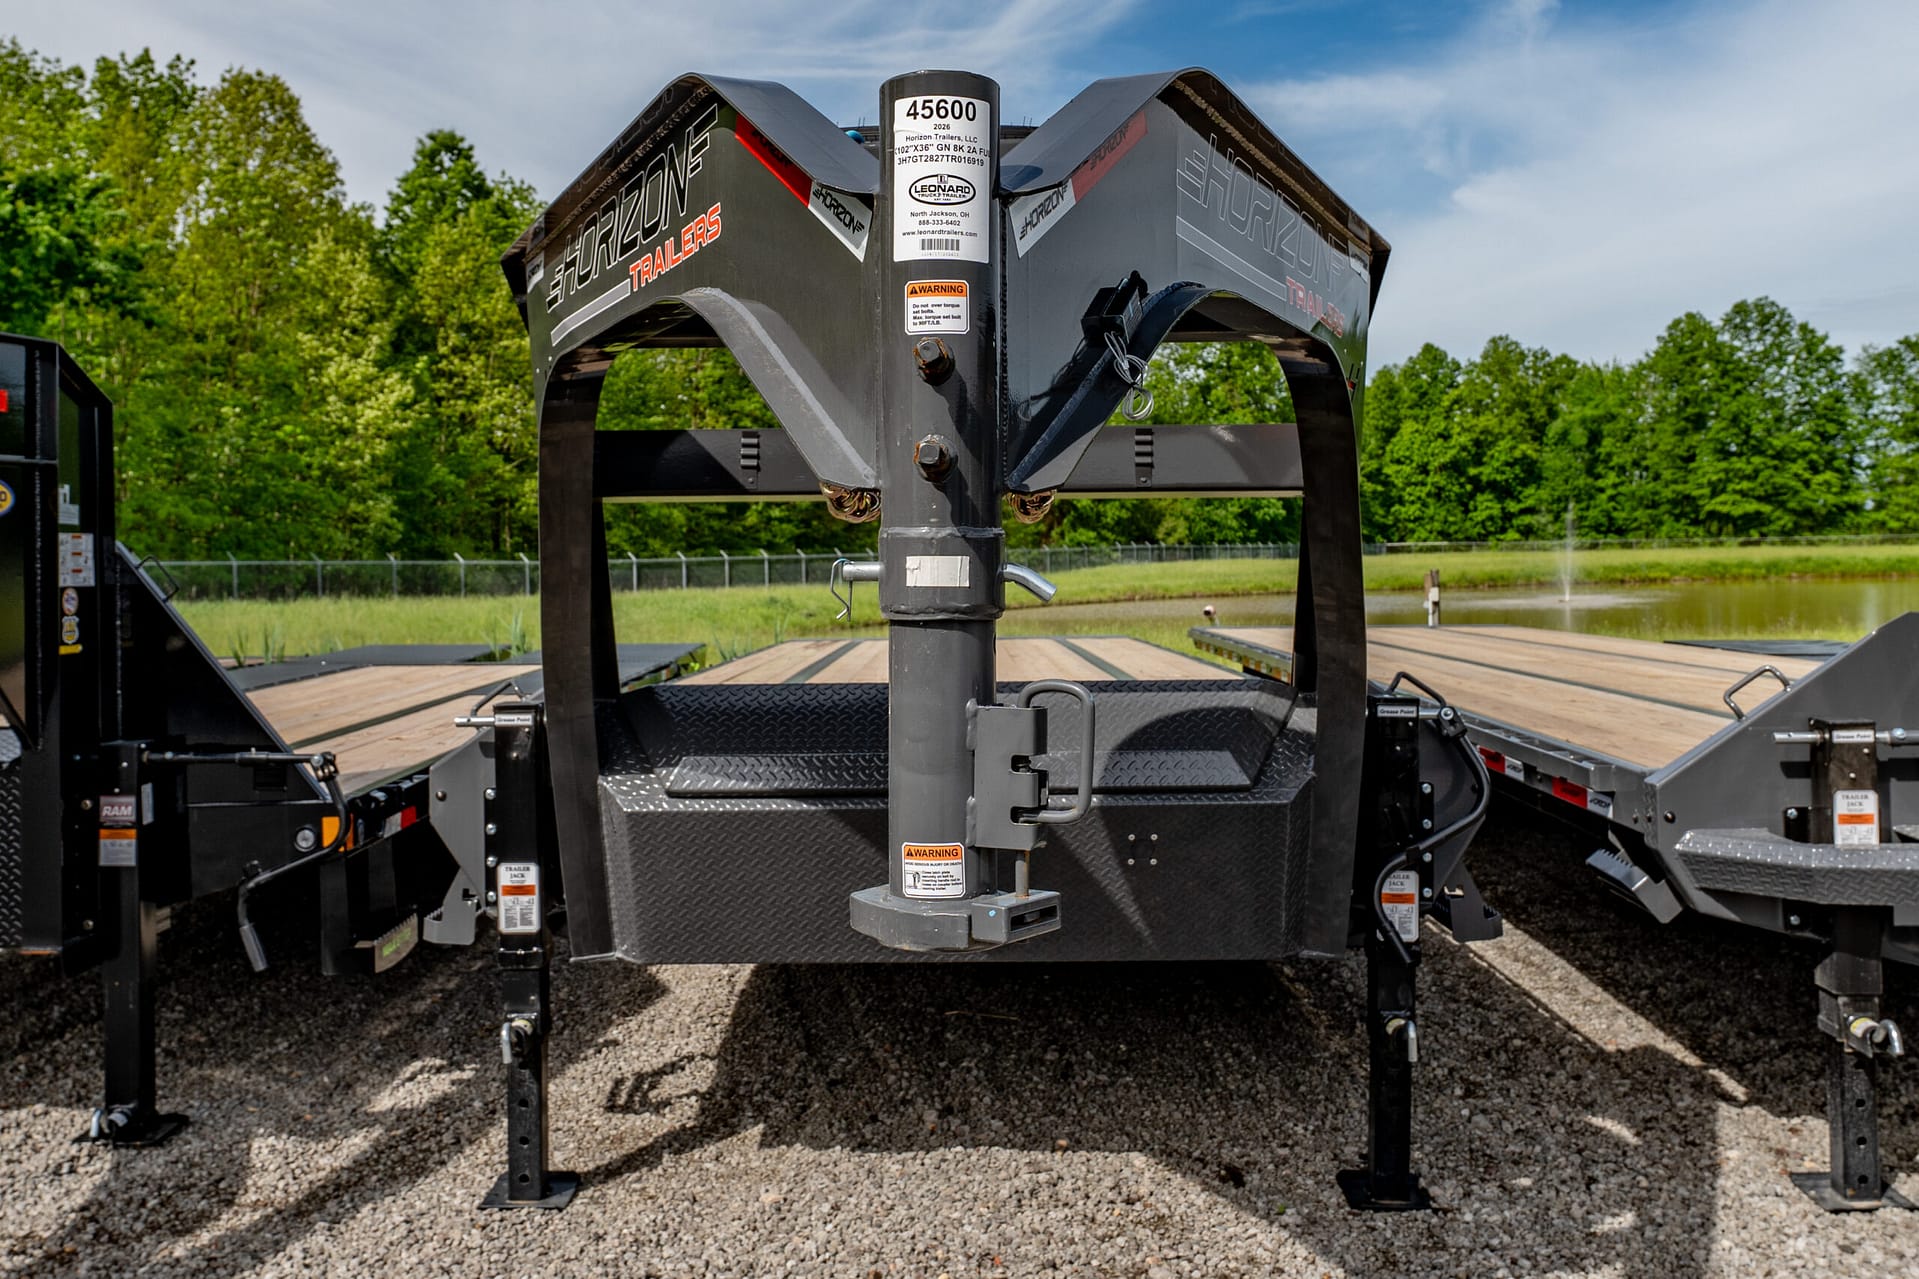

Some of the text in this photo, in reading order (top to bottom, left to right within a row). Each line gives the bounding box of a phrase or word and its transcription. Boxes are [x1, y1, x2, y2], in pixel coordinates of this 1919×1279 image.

[906, 98, 977, 122] 45600
[905, 134, 932, 142] Horizon
[934, 134, 963, 142] Trailers,
[936, 144, 950, 152] GN
[953, 145, 965, 153] 8K
[967, 146, 977, 154] 2A
[914, 184, 971, 194] LEONARD
[546, 103, 718, 313] HORIZON
[813, 186, 865, 235] HORIZON
[1019, 183, 1068, 241] HORIZON
[1176, 132, 1347, 292] HORIZON
[918, 219, 961, 227] 888-333-6402
[902, 229, 978, 237] www.leonardtrailers.com
[629, 202, 722, 292] TRAILERS
[918, 285, 964, 294] WARNING
[102, 805, 133, 817] RAM
[913, 848, 959, 857] WARNING
